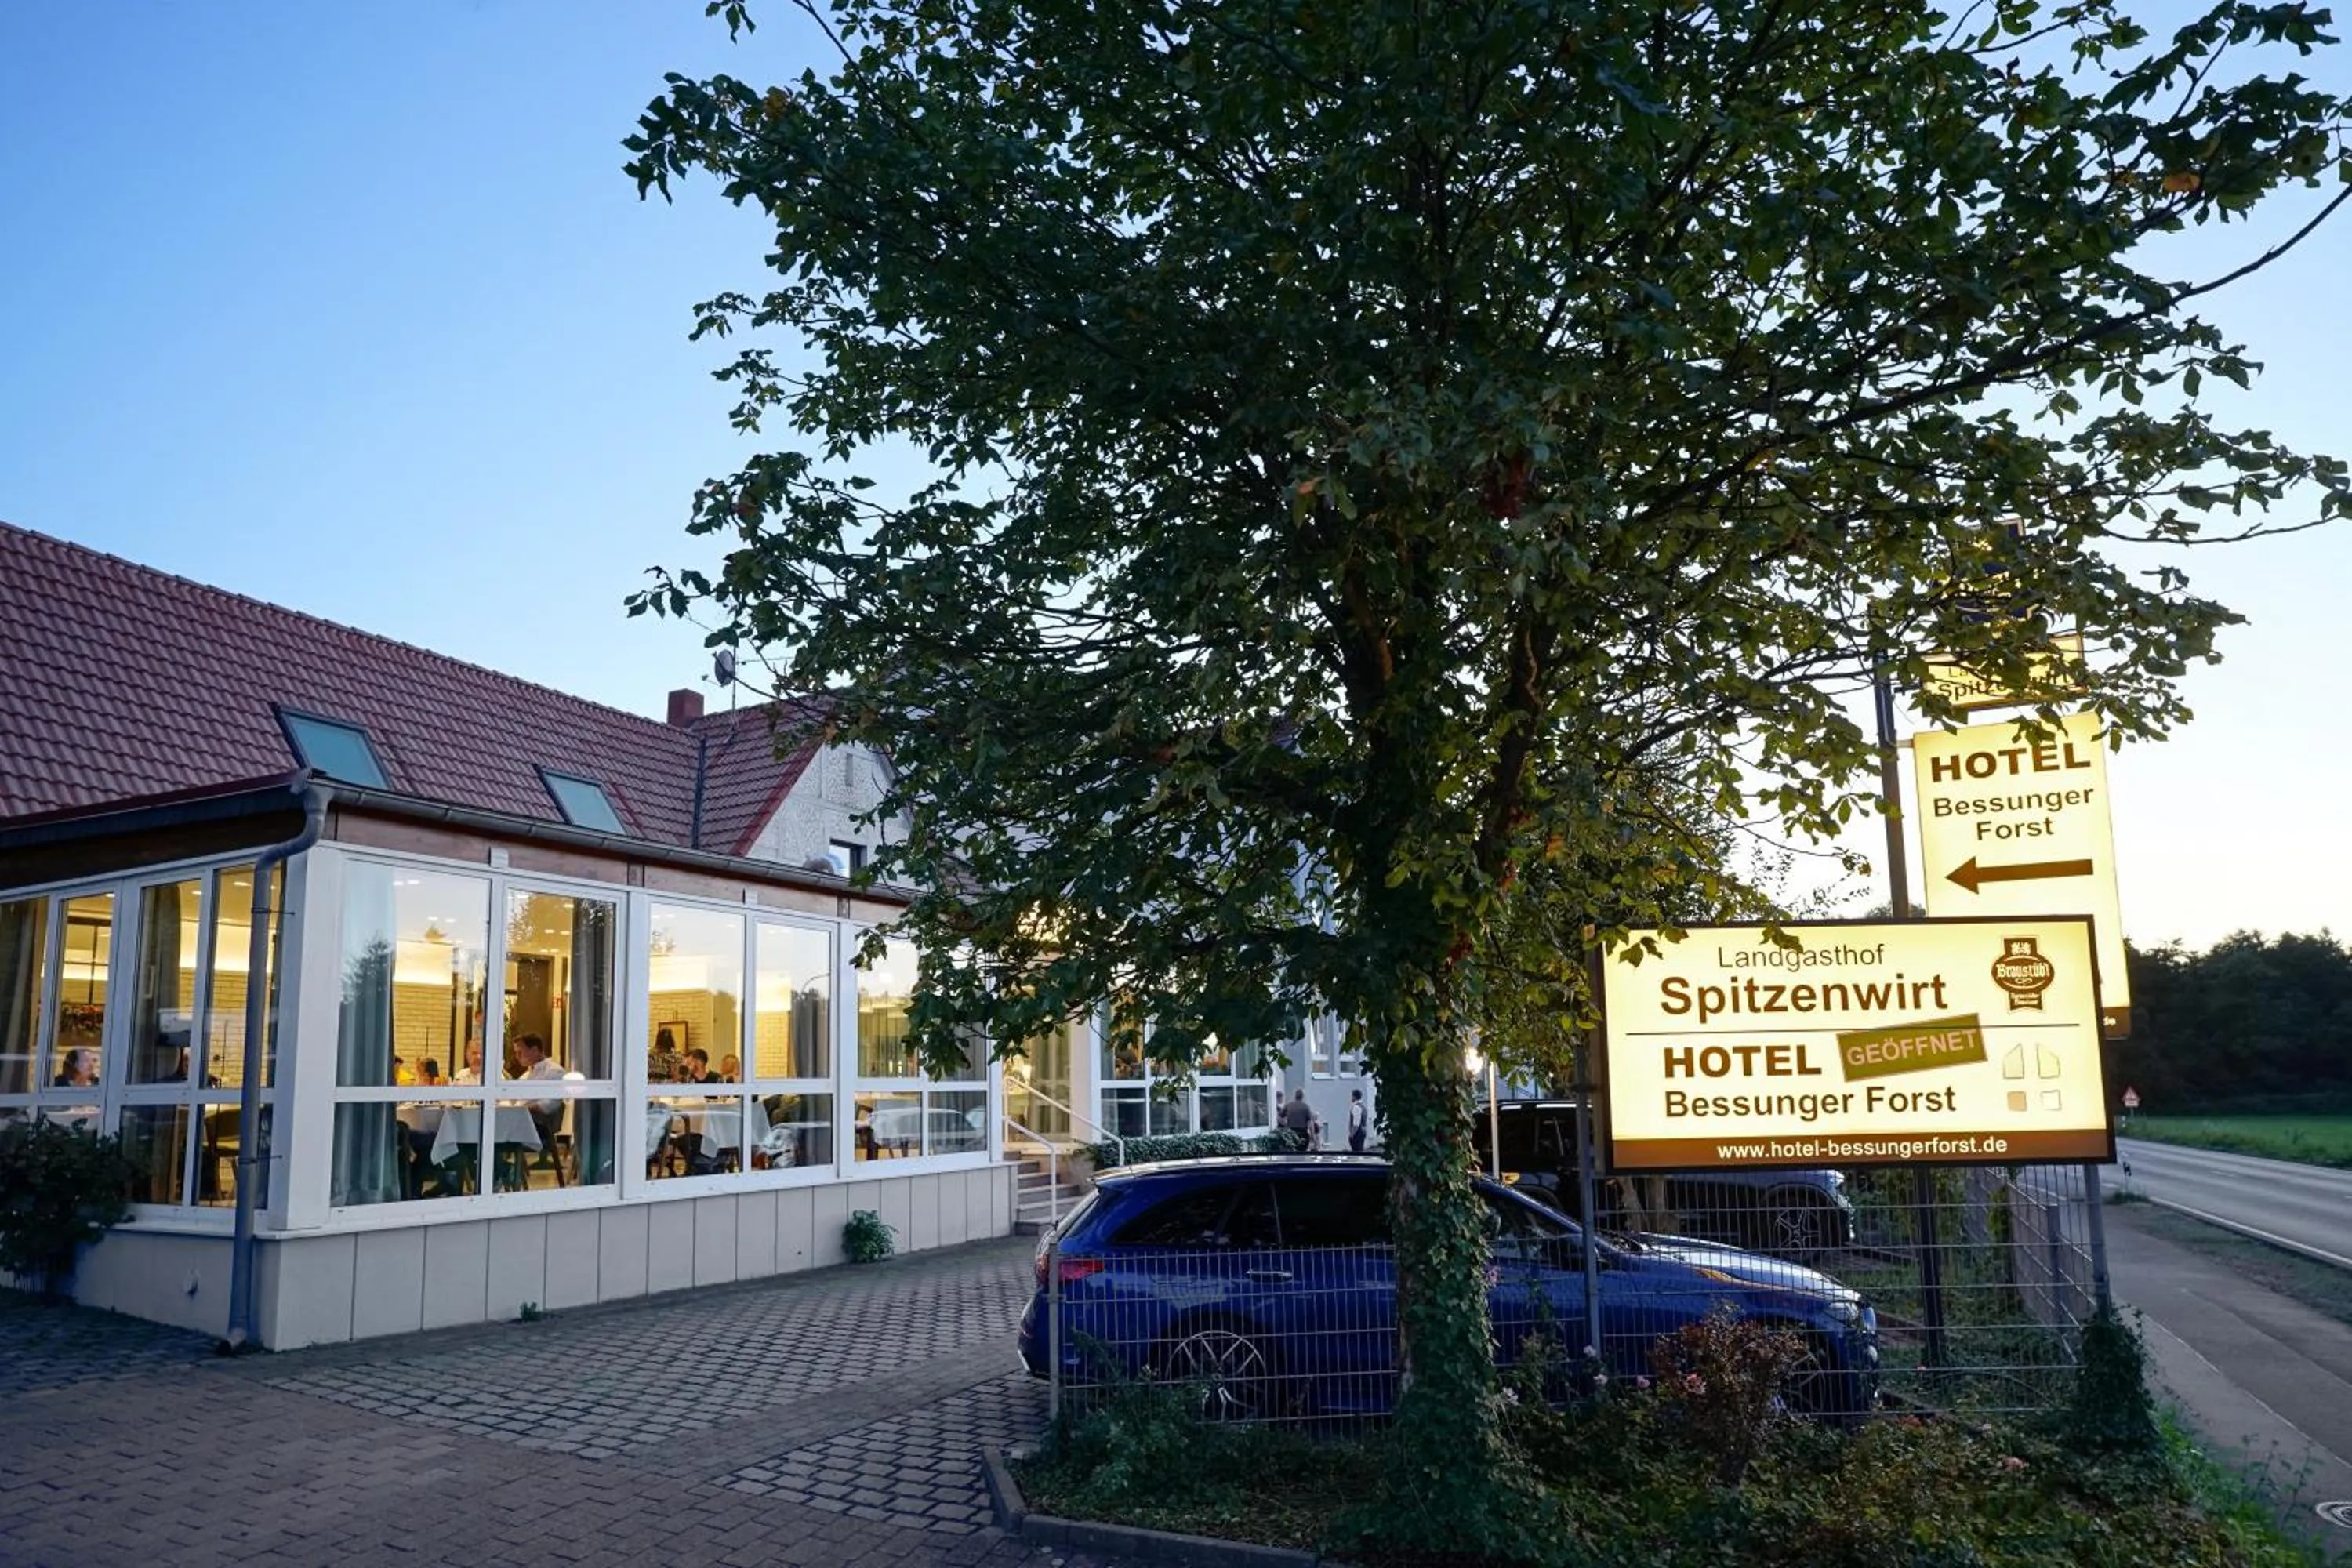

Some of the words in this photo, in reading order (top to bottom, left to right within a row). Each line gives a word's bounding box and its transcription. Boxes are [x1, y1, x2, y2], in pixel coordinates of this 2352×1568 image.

[1930, 742, 2091, 782] HOTEL
[1933, 788, 2094, 817] Bessunger
[1976, 817, 2055, 841] Forst
[1718, 943, 1885, 972] Landgasthof
[1660, 973, 1948, 1024] Spitzenwirt
[1663, 1044, 1822, 1079] HOTEL
[1846, 1028, 1978, 1066] GEÖFFNET
[1664, 1090, 1854, 1122] Bessunger
[1866, 1085, 1958, 1113] Forst
[1717, 1137, 2009, 1160] www.hotel-bessungerforst.de
